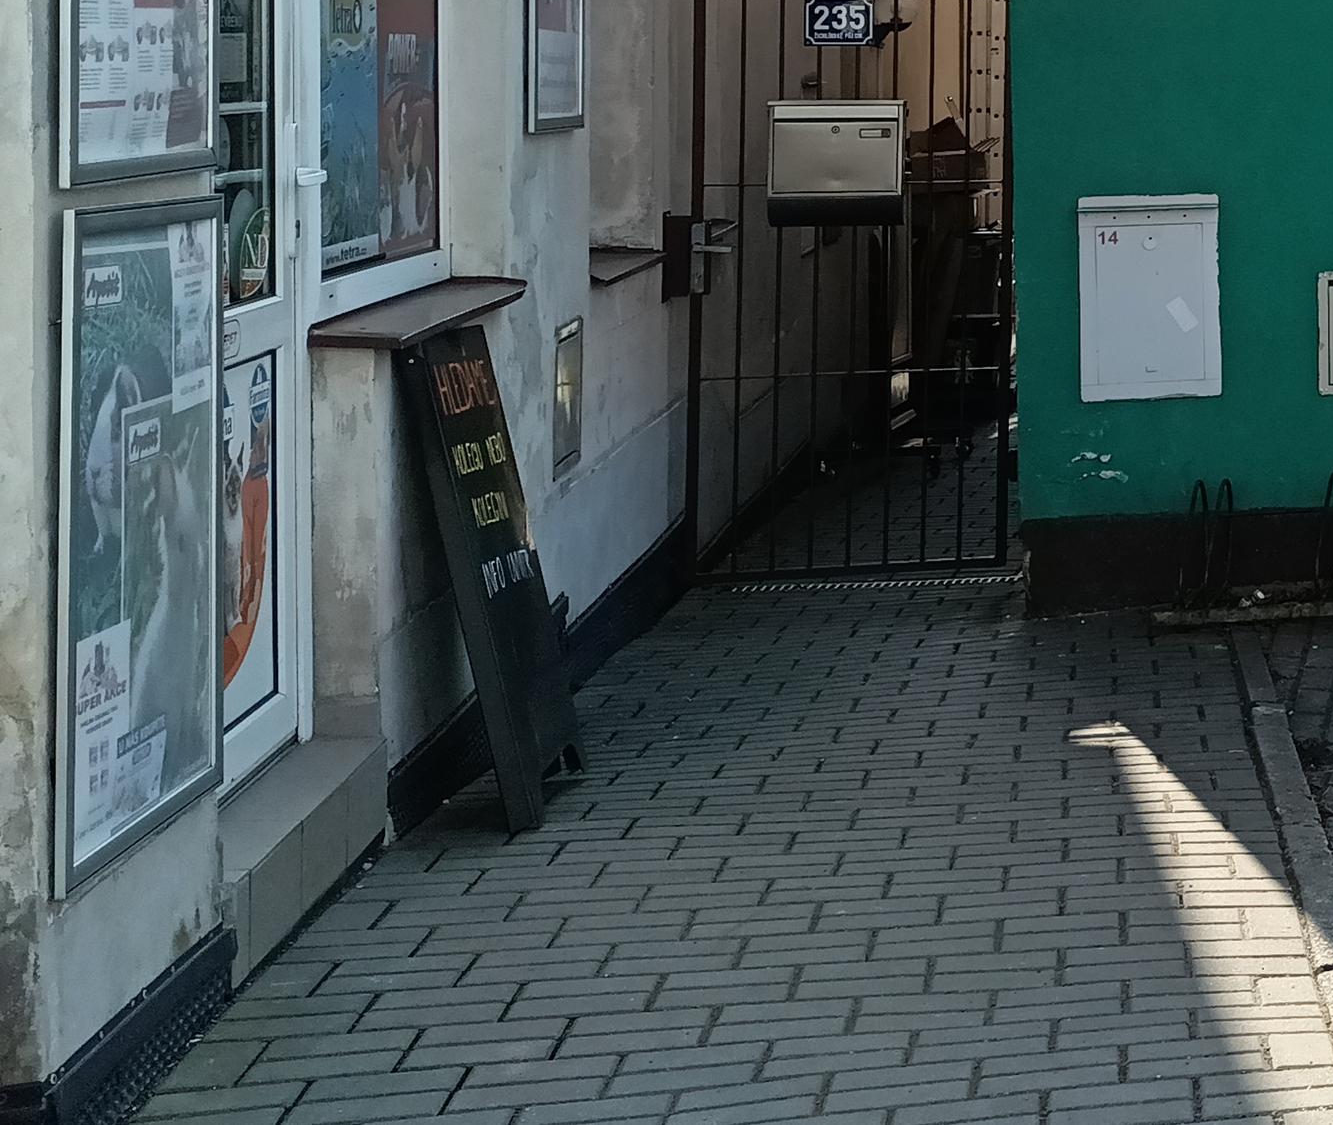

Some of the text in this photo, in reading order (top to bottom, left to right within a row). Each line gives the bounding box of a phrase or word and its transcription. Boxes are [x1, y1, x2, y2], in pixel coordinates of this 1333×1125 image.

[814, 5, 866, 30] 235
[1098, 231, 1118, 245] 14
[452, 432, 507, 477] KOLEGU NEBO
[482, 557, 506, 599] INFO
[77, 679, 127, 716] UPER AKCE
